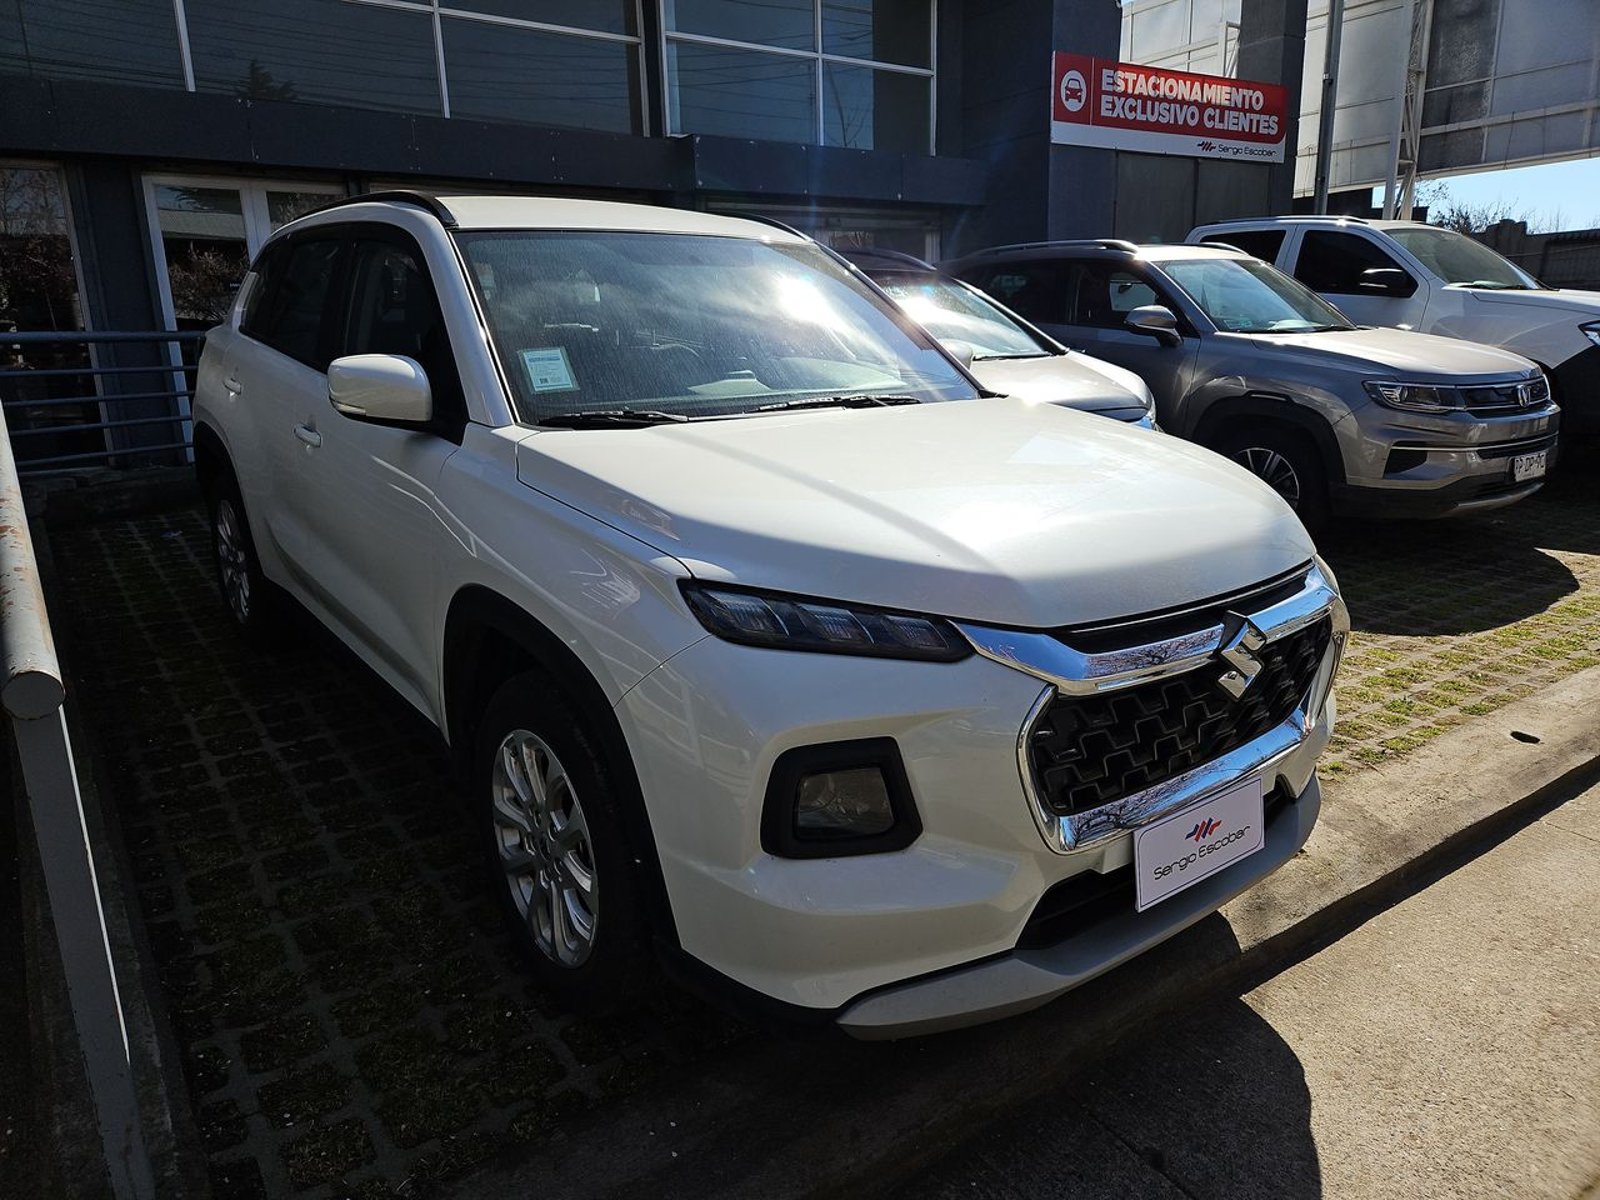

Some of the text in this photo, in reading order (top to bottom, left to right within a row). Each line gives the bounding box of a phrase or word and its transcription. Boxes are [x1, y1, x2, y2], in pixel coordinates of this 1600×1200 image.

[1101, 69, 1264, 111] ESTACIONAMIENTO
[1100, 94, 1279, 136] EXCLUSIVO CLIENTES
[1199, 825, 1251, 859] Escobar
